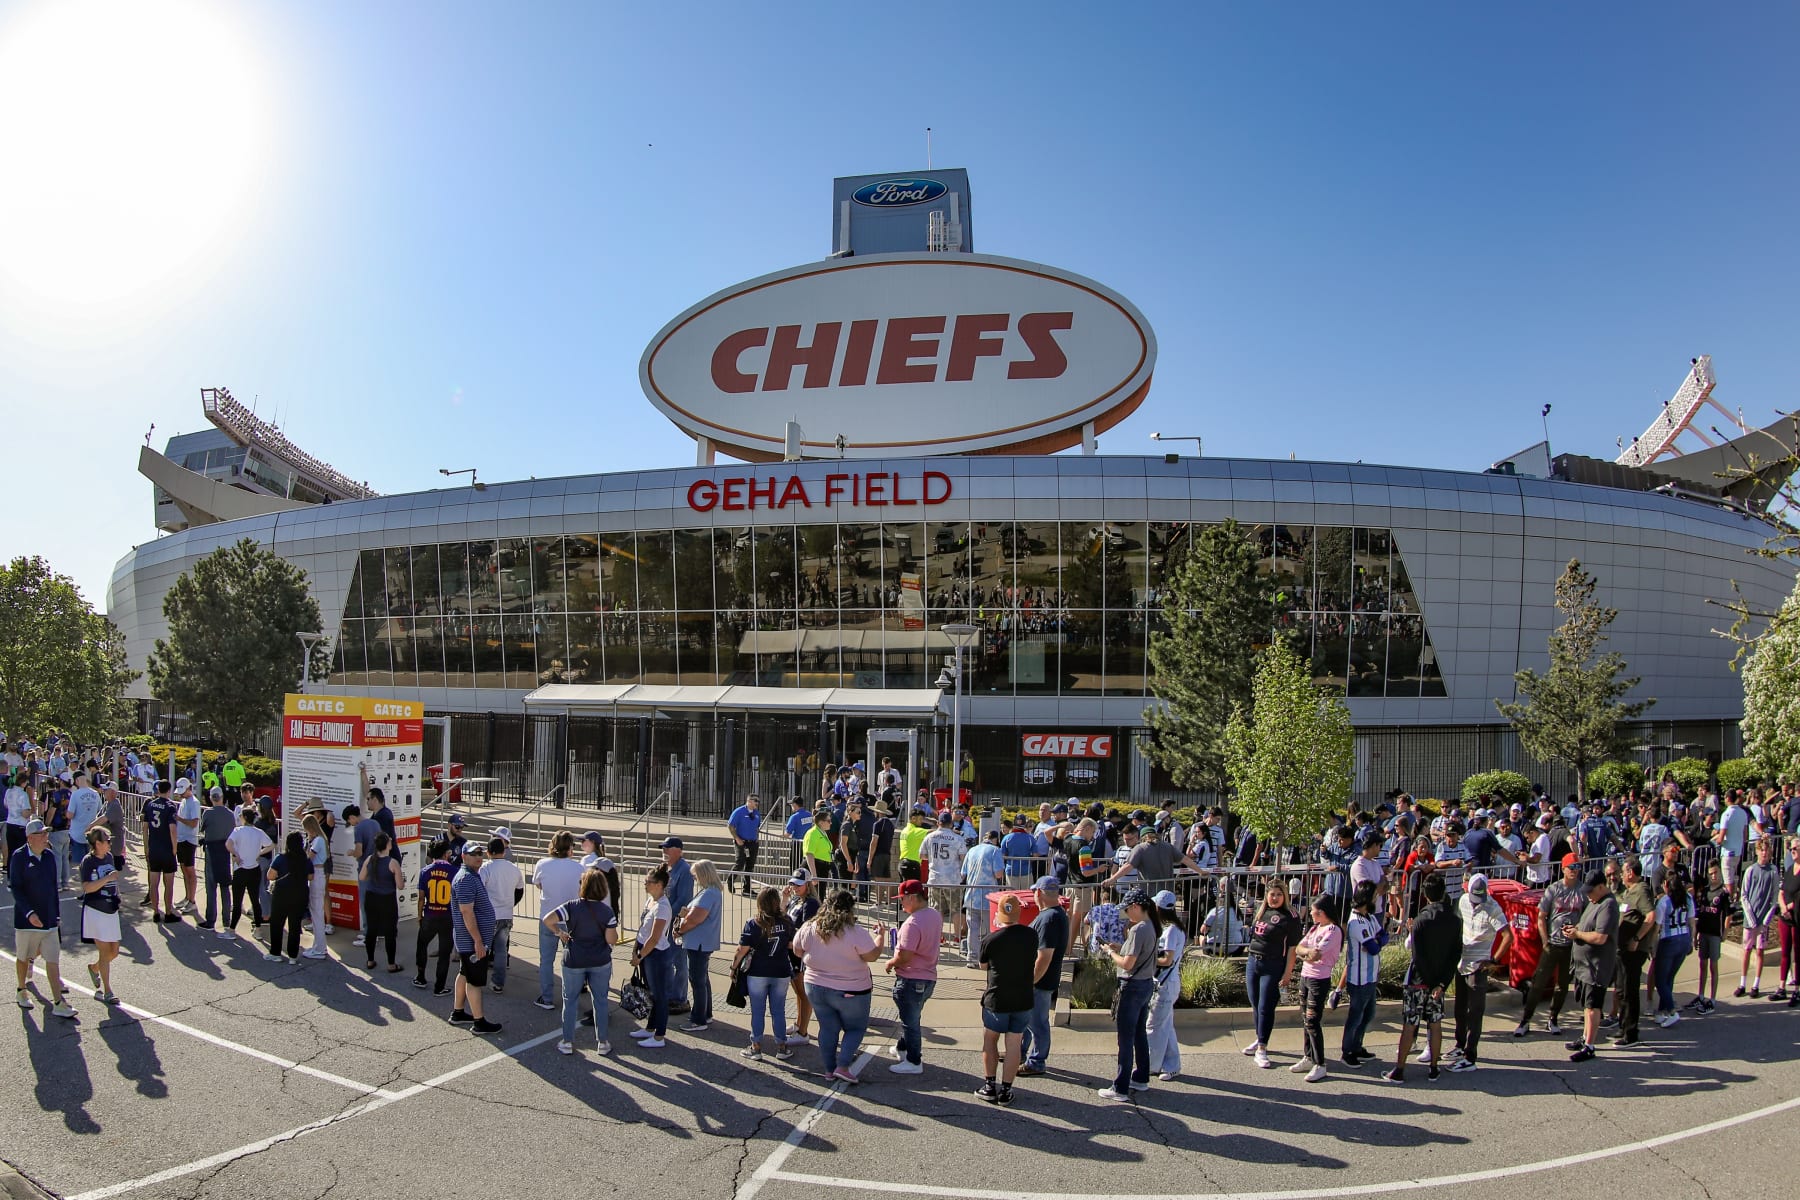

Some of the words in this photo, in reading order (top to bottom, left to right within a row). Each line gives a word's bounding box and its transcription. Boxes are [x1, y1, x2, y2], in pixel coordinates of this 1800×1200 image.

[869, 181, 929, 203] Ford
[711, 312, 1073, 393] CHIEFS
[688, 475, 811, 512] GEHA
[825, 472, 952, 506] FIELD
[298, 699, 332, 713] GATE
[335, 701, 345, 714] C
[374, 704, 402, 717] GATE
[404, 706, 412, 718] C
[290, 720, 303, 739] FAN
[321, 721, 354, 744] CONDUCT
[1023, 735, 1088, 755] GATE
[1091, 736, 1110, 756] C
[151, 810, 161, 828] 3
[932, 842, 950, 860] 15
[430, 870, 449, 878] MESSI
[427, 879, 451, 905] 10
[767, 936, 780, 957] 7
